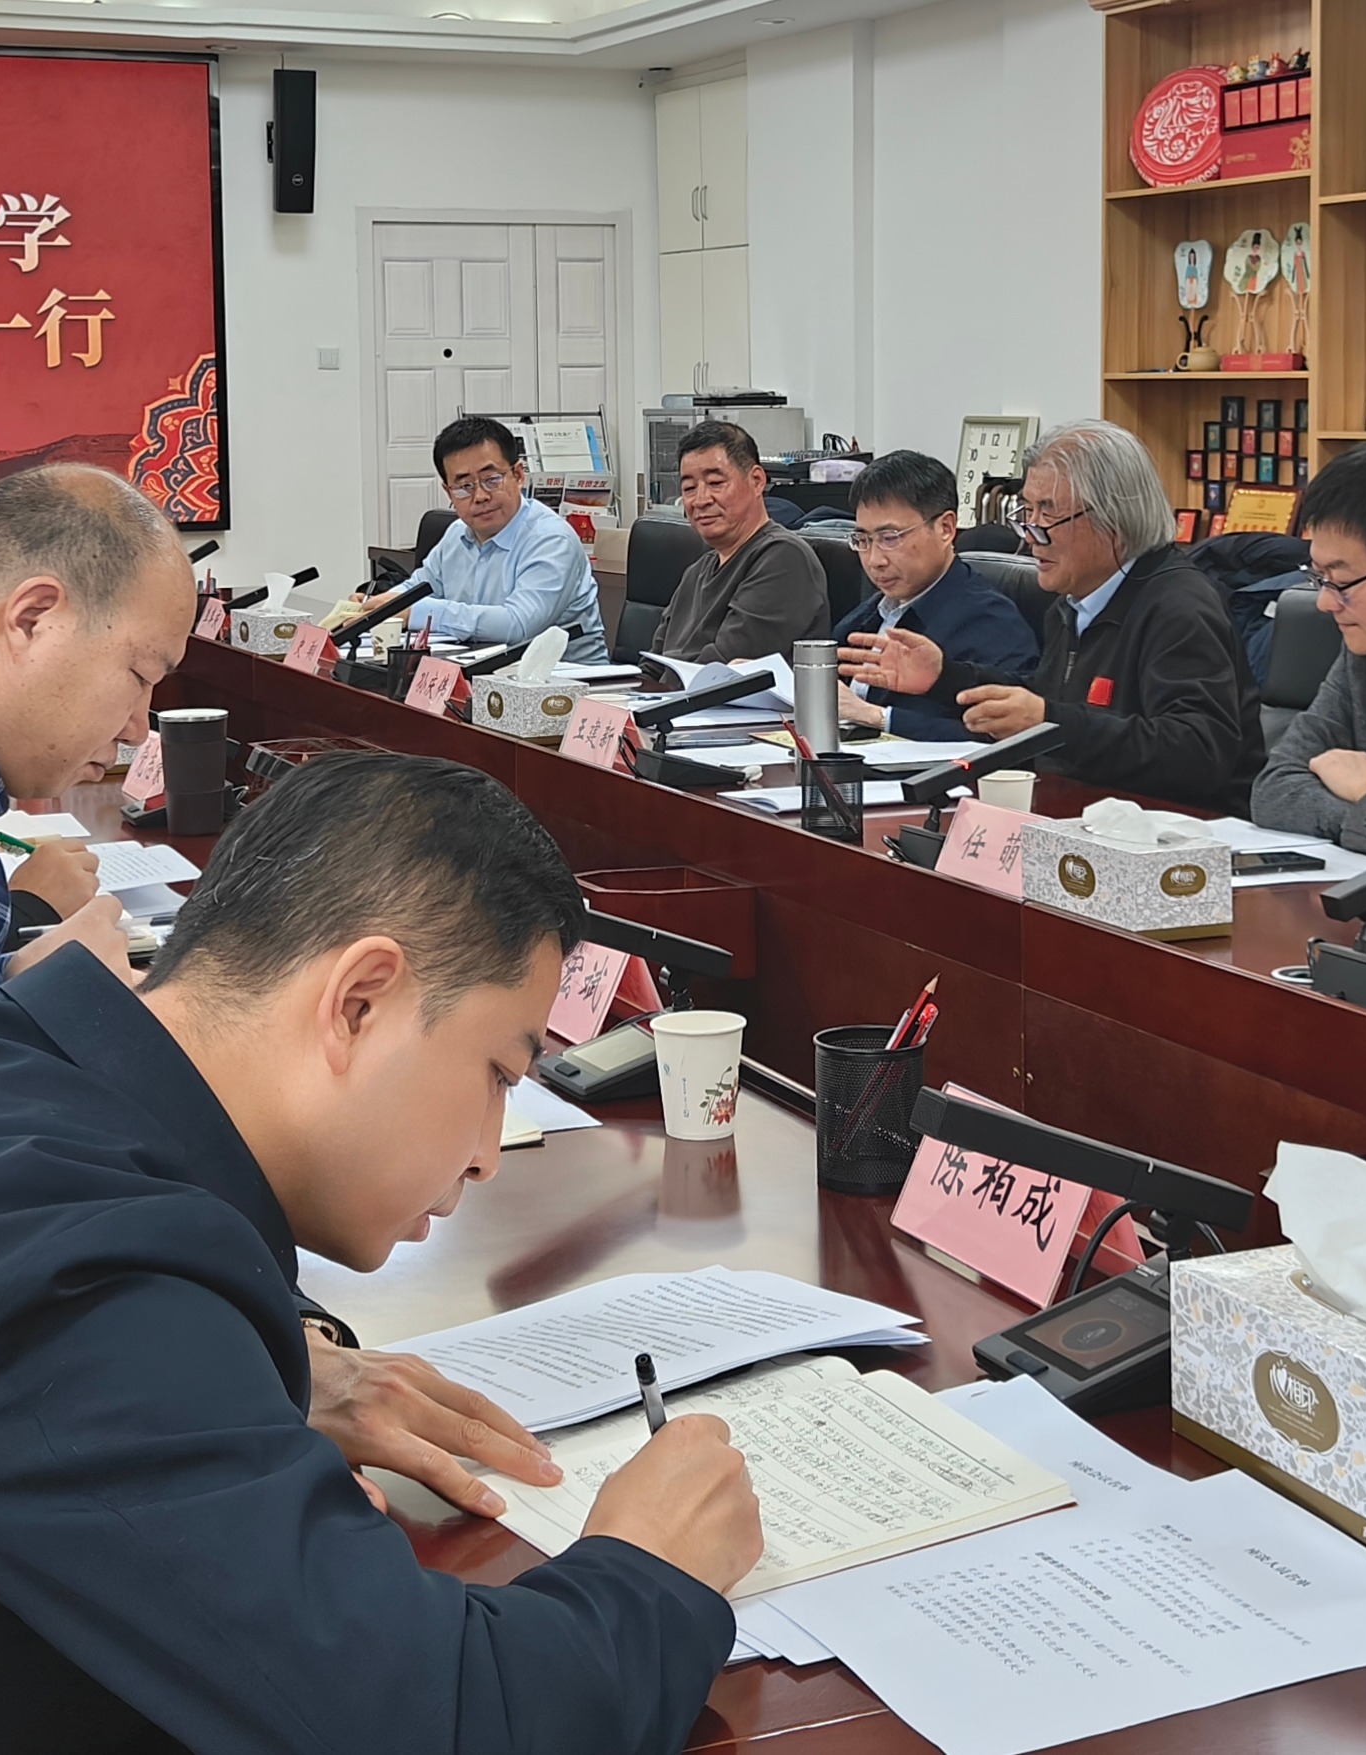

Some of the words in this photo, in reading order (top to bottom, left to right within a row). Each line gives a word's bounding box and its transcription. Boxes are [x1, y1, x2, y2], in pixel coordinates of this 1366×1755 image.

[979, 433, 987, 446] 11
[991, 433, 1000, 446] 12
[970, 448, 978, 461] 10
[1010, 450, 1017, 463] 2
[967, 470, 974, 483] 9
[964, 492, 971, 504] 8
[1269, 1359, 1319, 1414] 心相印
